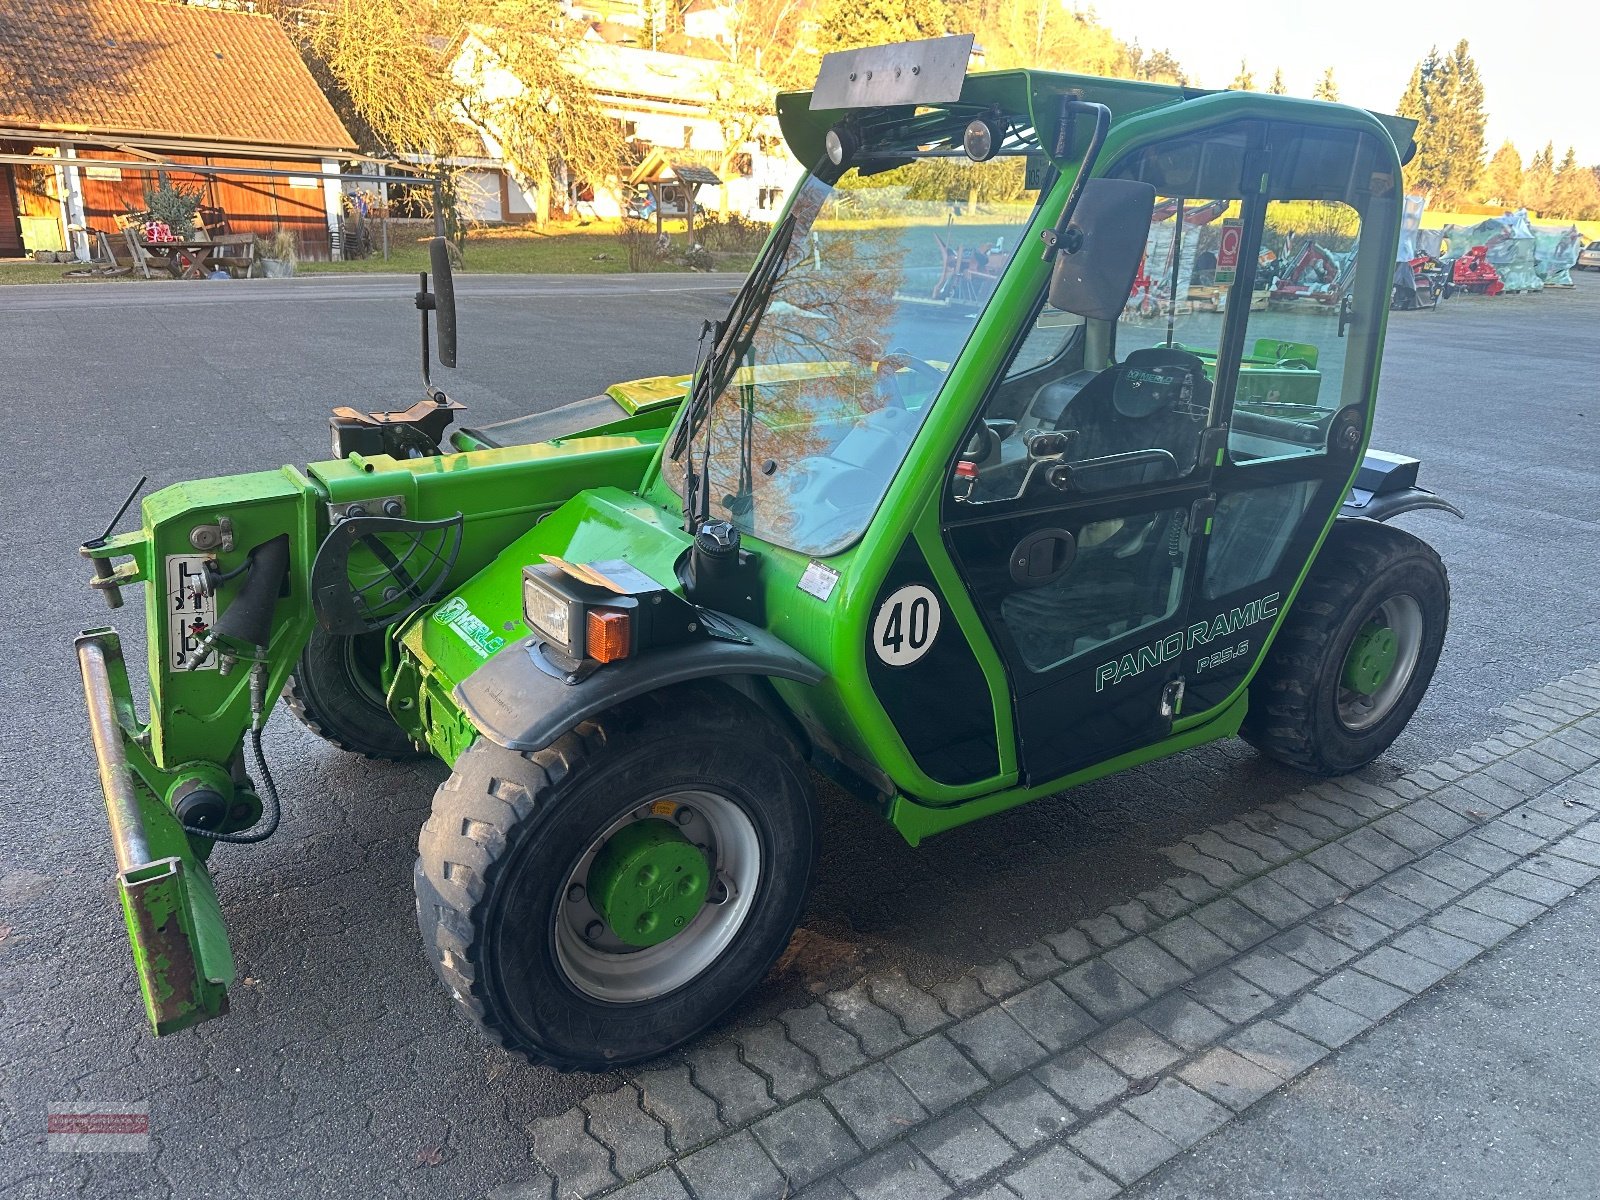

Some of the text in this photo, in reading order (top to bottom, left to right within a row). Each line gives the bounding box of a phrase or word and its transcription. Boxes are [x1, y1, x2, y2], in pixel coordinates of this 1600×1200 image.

[1140, 372, 1174, 384] MERLO
[453, 609, 505, 654] MERLO
[882, 597, 930, 653] 40
[1196, 639, 1249, 674] P25.6
